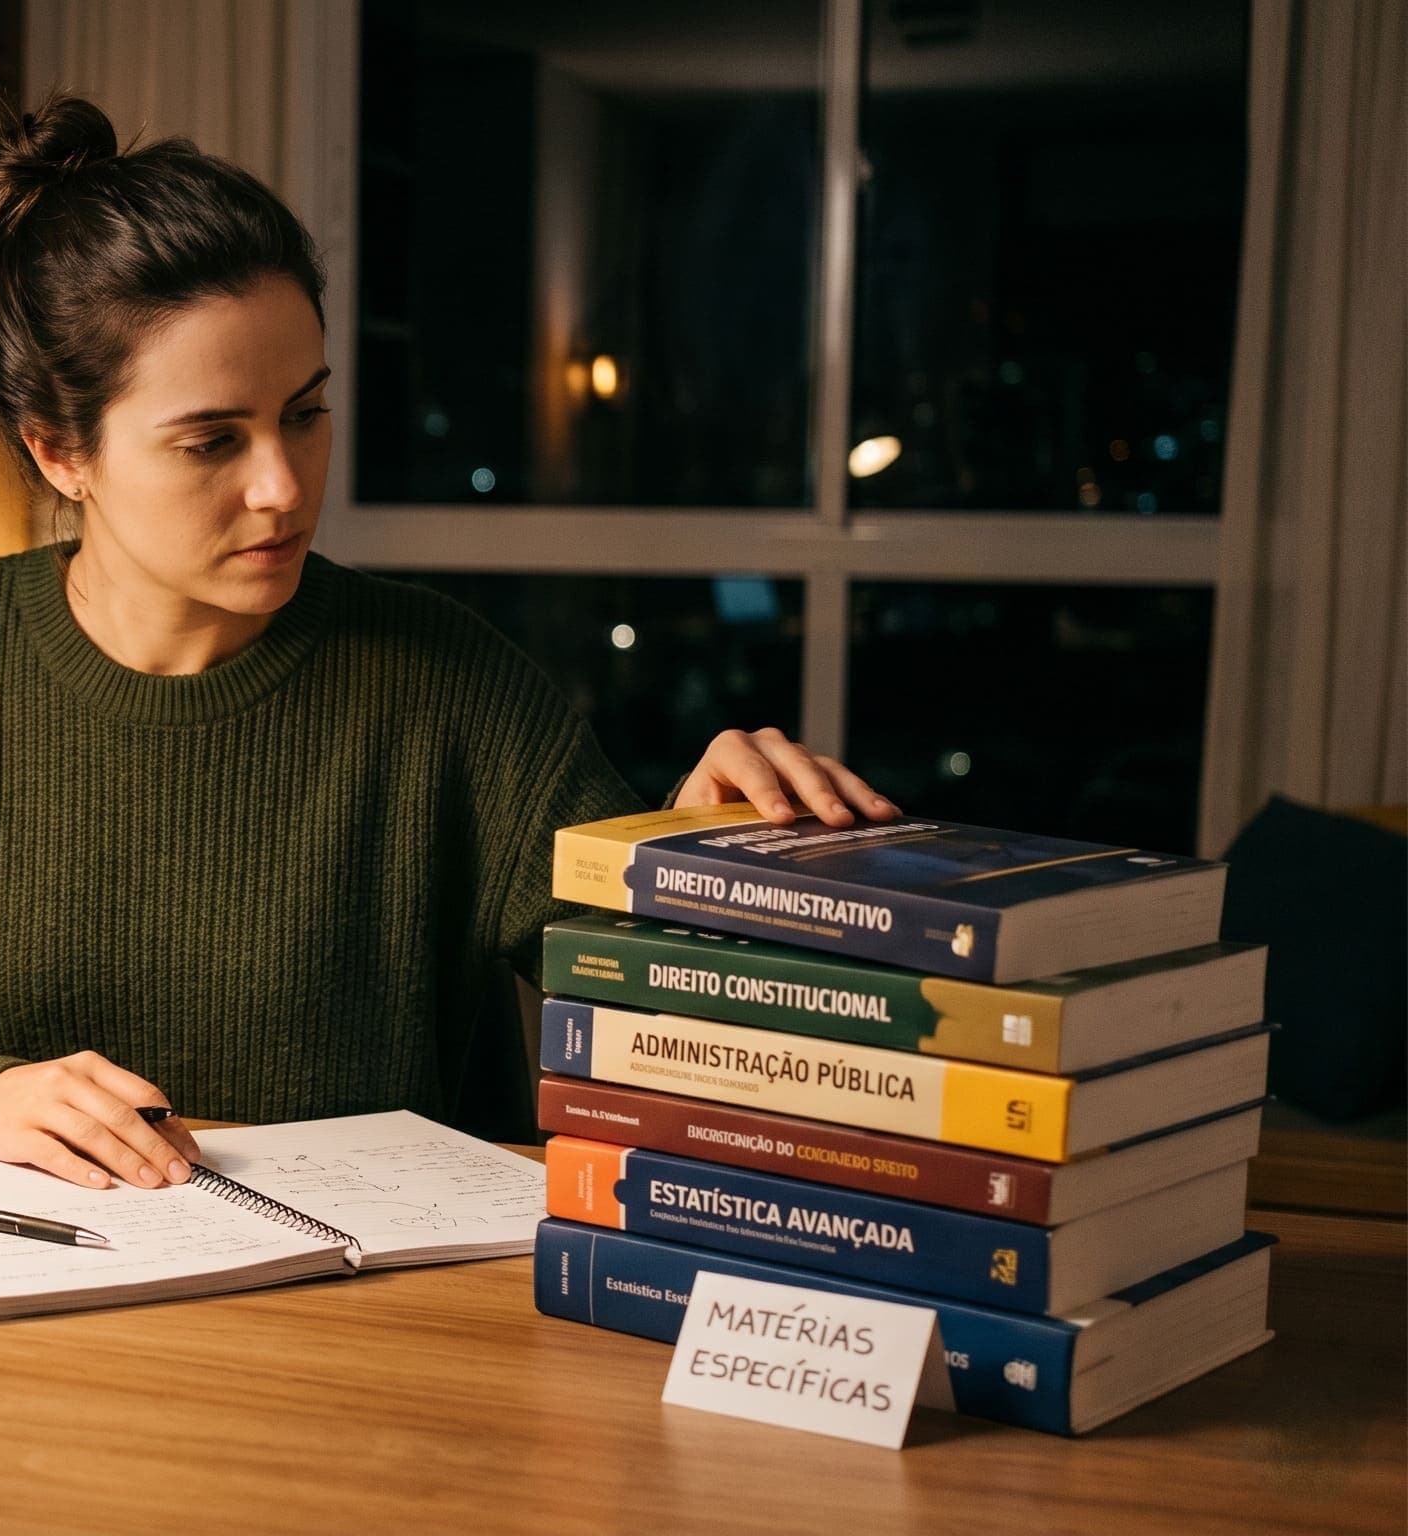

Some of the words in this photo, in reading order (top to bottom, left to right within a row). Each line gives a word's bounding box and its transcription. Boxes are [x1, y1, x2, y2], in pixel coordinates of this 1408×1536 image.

[655, 866, 726, 901] DIREITO
[729, 881, 893, 933] ADMINISTRATIVO
[648, 963, 721, 997] DIREITO
[724, 974, 892, 1024] CONSTITUCIONAL
[631, 1032, 809, 1084] ADMINISTRAÇÃO
[817, 1058, 915, 1102] PÚBLICA
[775, 1141, 795, 1158] DO
[649, 1179, 782, 1228] ESTATÍSTICA
[786, 1206, 915, 1253] AVANÇADA
